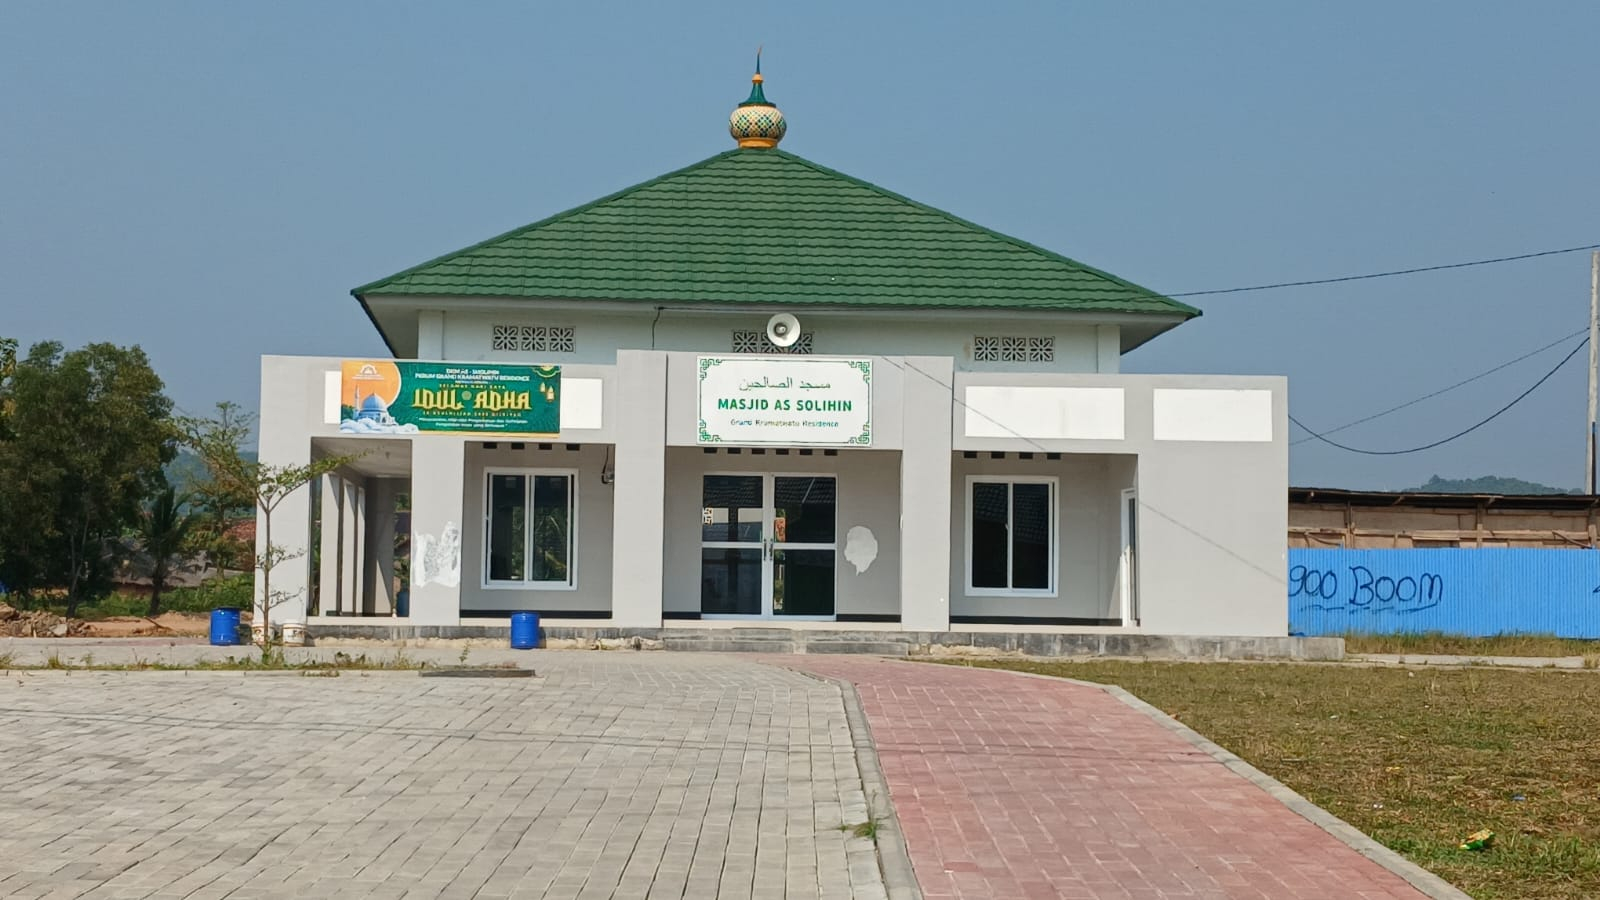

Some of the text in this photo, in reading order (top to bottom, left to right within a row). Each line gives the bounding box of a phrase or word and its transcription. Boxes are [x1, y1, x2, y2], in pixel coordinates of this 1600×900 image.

[739, 376, 793, 391] الصالحين
[412, 388, 532, 411] IDUL ADHA
[717, 398, 852, 412] MASJID AS SOLIHIN
[802, 419, 839, 427] Residence
